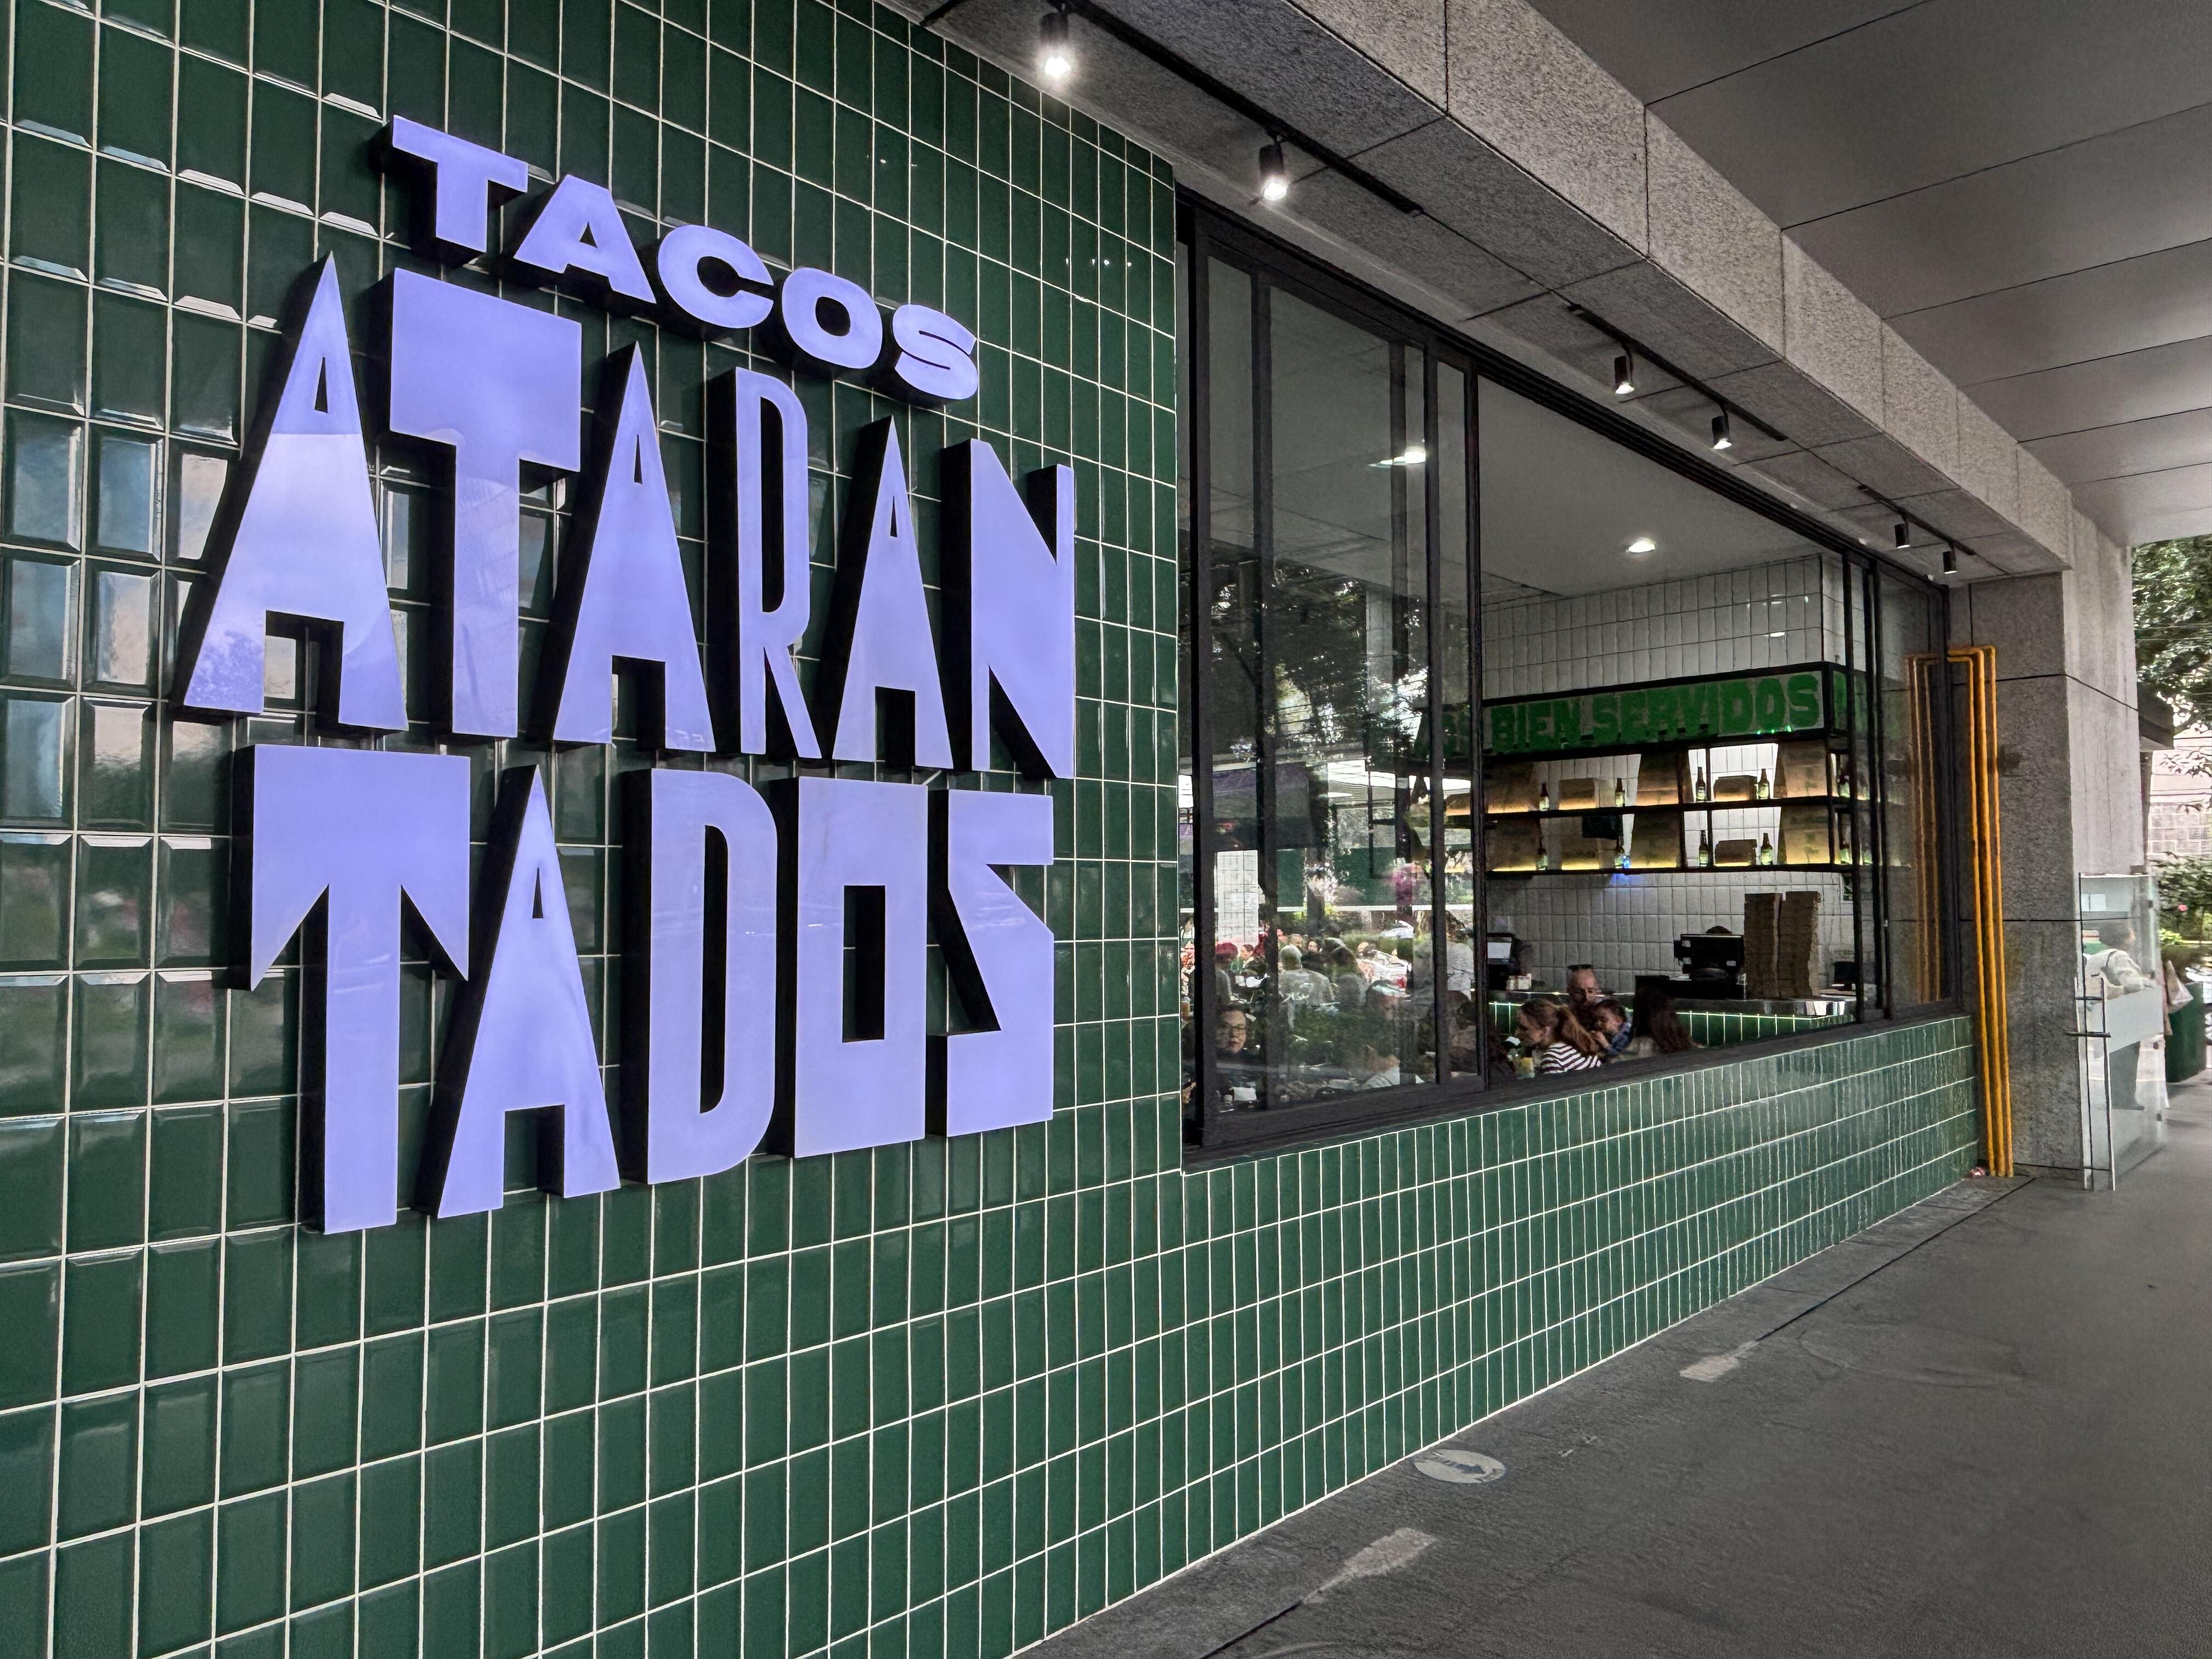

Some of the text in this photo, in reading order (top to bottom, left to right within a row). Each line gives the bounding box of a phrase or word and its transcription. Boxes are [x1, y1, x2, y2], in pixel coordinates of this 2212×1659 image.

[391, 115, 978, 400] TACOS
[184, 252, 1075, 778] ATARAN
[1491, 698, 1581, 754] BIEN
[1593, 674, 1819, 747] SERVIDOS
[252, 744, 1054, 1235] TADOS
